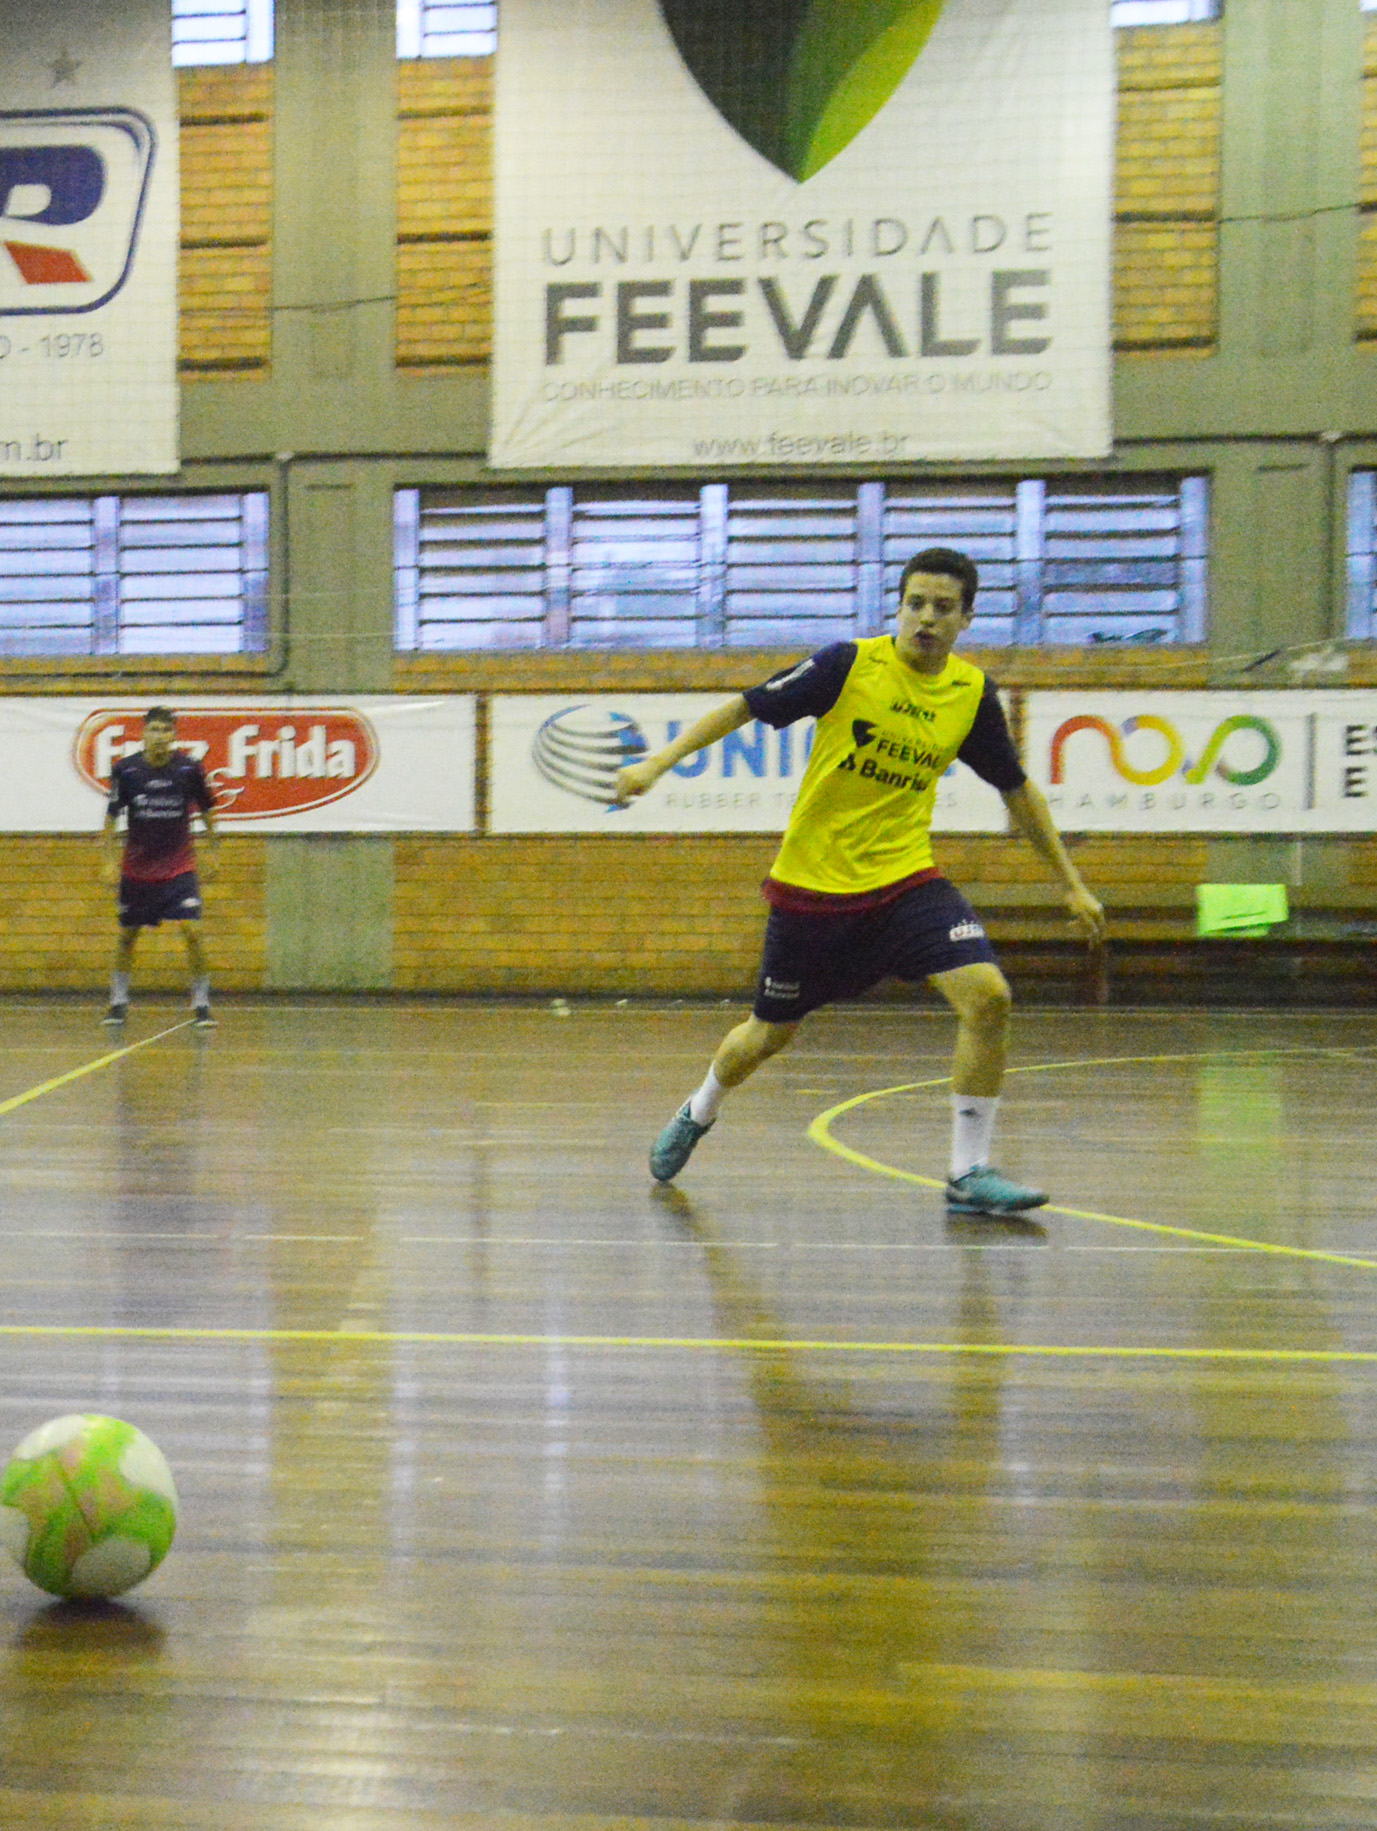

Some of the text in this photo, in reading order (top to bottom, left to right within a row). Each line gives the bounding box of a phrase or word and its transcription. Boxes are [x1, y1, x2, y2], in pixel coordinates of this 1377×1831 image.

[541, 211, 1055, 267] UNIVERSIDADE
[543, 268, 1055, 367] FEEVALE
[39, 331, 106, 360] 1978
[543, 377, 747, 402] CONHECIMENTO
[751, 376, 818, 399] PARA
[825, 372, 922, 397] INOVAR
[952, 369, 1054, 394] MUNDO
[692, 430, 912, 458] www.feevale.br
[664, 791, 761, 809] RUBBER
